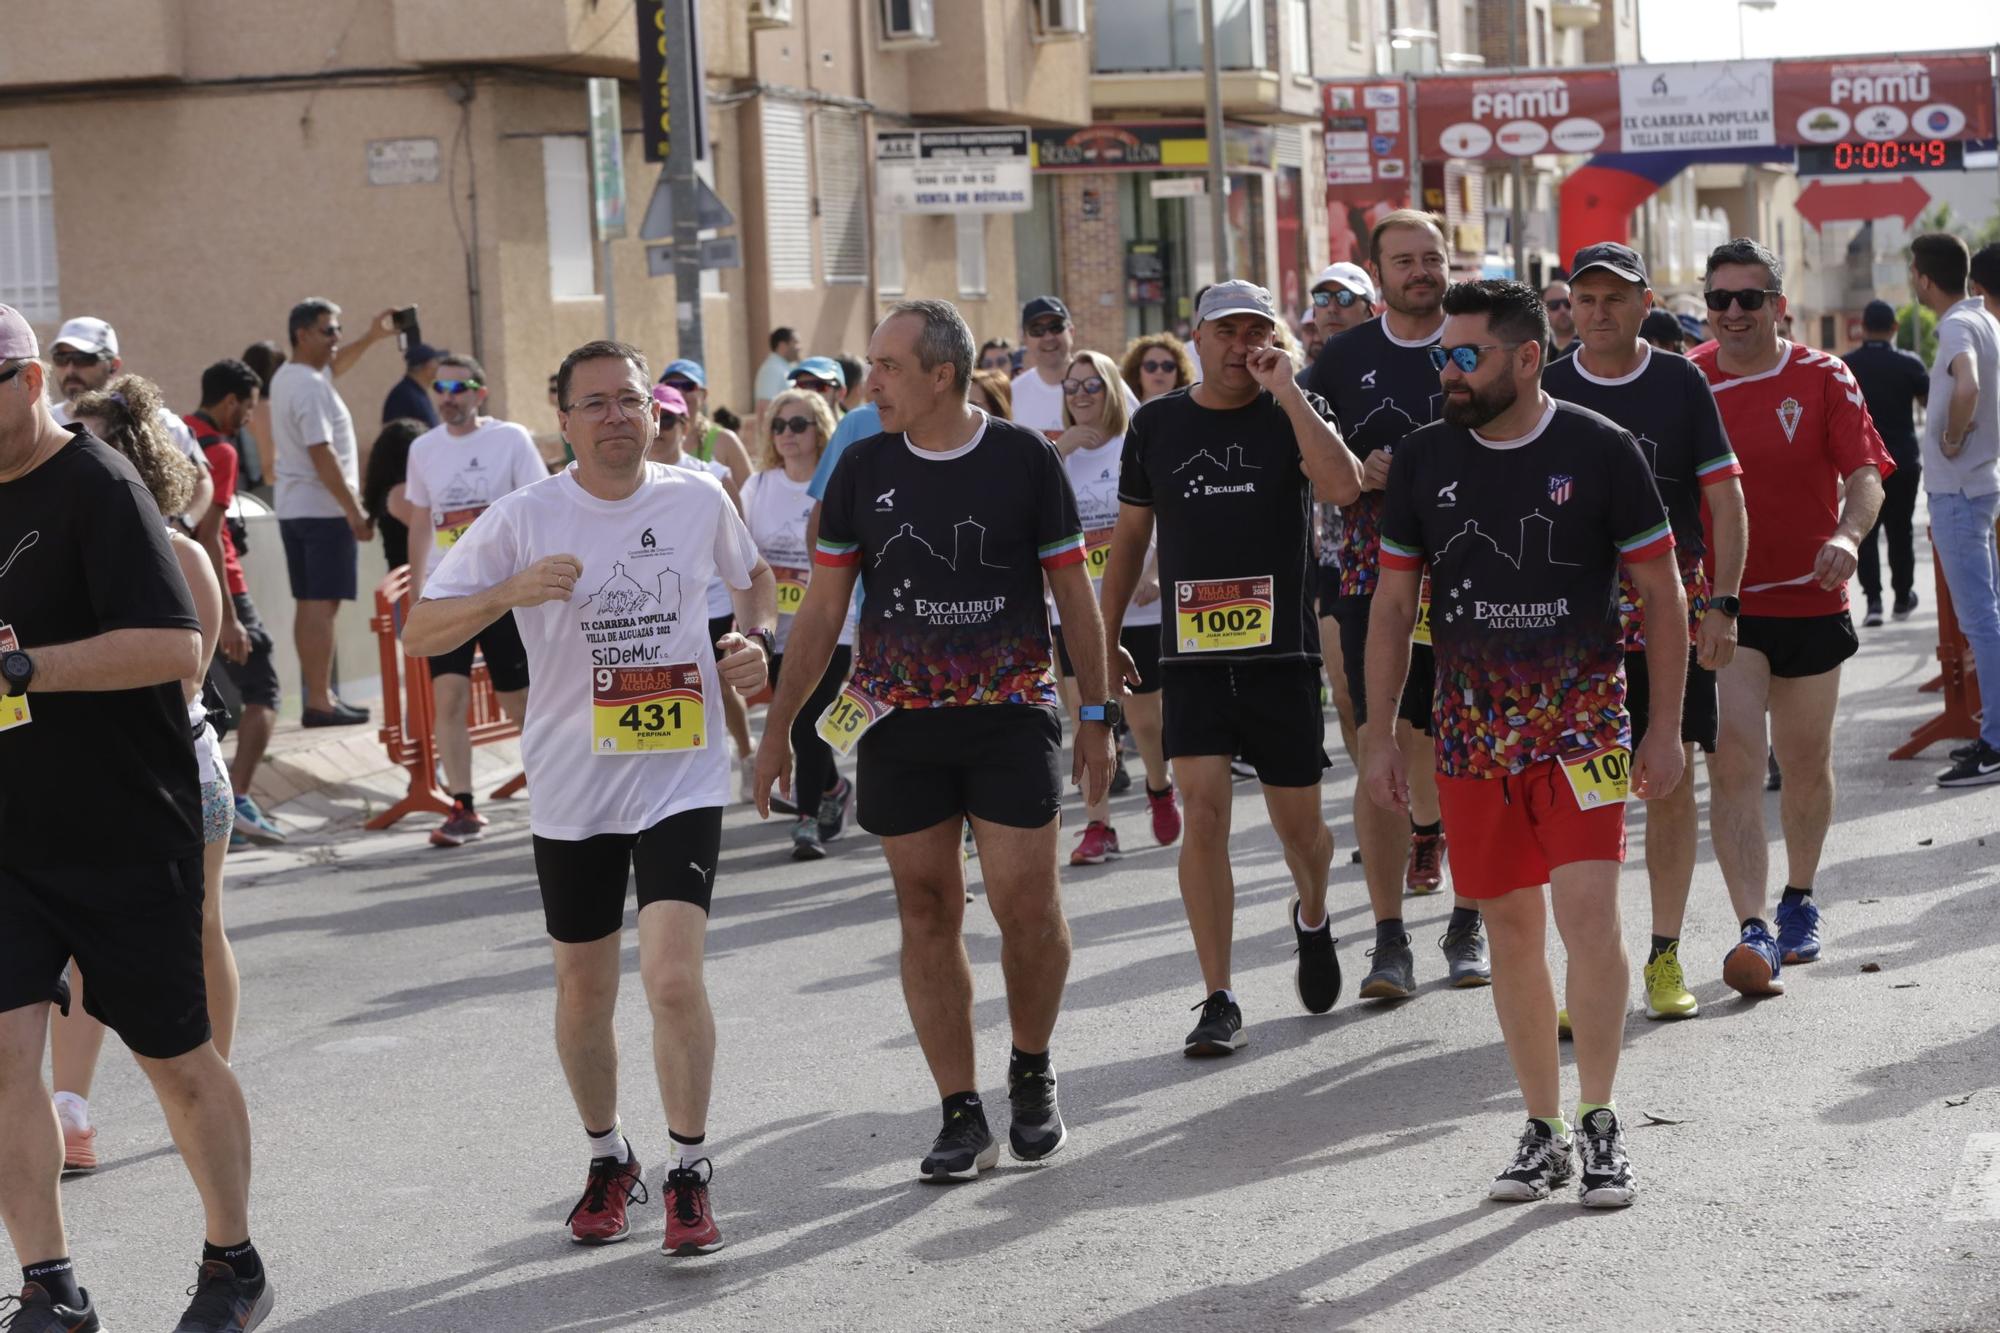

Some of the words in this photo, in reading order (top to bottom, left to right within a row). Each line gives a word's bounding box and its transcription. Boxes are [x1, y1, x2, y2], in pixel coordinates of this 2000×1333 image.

[1830, 75, 1930, 104] FAMU
[1472, 91, 1570, 120] FAMU
[1624, 116, 1638, 129] IX
[1641, 113, 1704, 127] CARRERA
[1708, 110, 1770, 125] POPULAR
[1630, 132, 1661, 146] VILLA
[1663, 132, 1676, 145] DE
[1679, 130, 1731, 144] ALGUAZAS
[1835, 140, 1945, 169] 0:00:49
[1204, 482, 1256, 496] EXCALIBUR
[914, 596, 1006, 616] EXCALIBUR
[1473, 598, 1571, 619] EXCALIBUR
[581, 622, 590, 631] IX
[592, 617, 636, 630] CARRERA
[637, 612, 677, 625] POPULAR
[928, 612, 993, 625] ALGUAZAS
[1191, 608, 1262, 633] 1002
[1488, 615, 1556, 629] ALGUAZAS
[586, 632, 607, 643] VILLA
[607, 631, 617, 642] DE
[617, 626, 654, 640] ALGUAZAS
[657, 625, 671, 635] 2022
[620, 673, 655, 682] VILLA
[658, 672, 672, 682] DE
[620, 681, 672, 691] ALGUAZAS
[619, 702, 681, 731] 431
